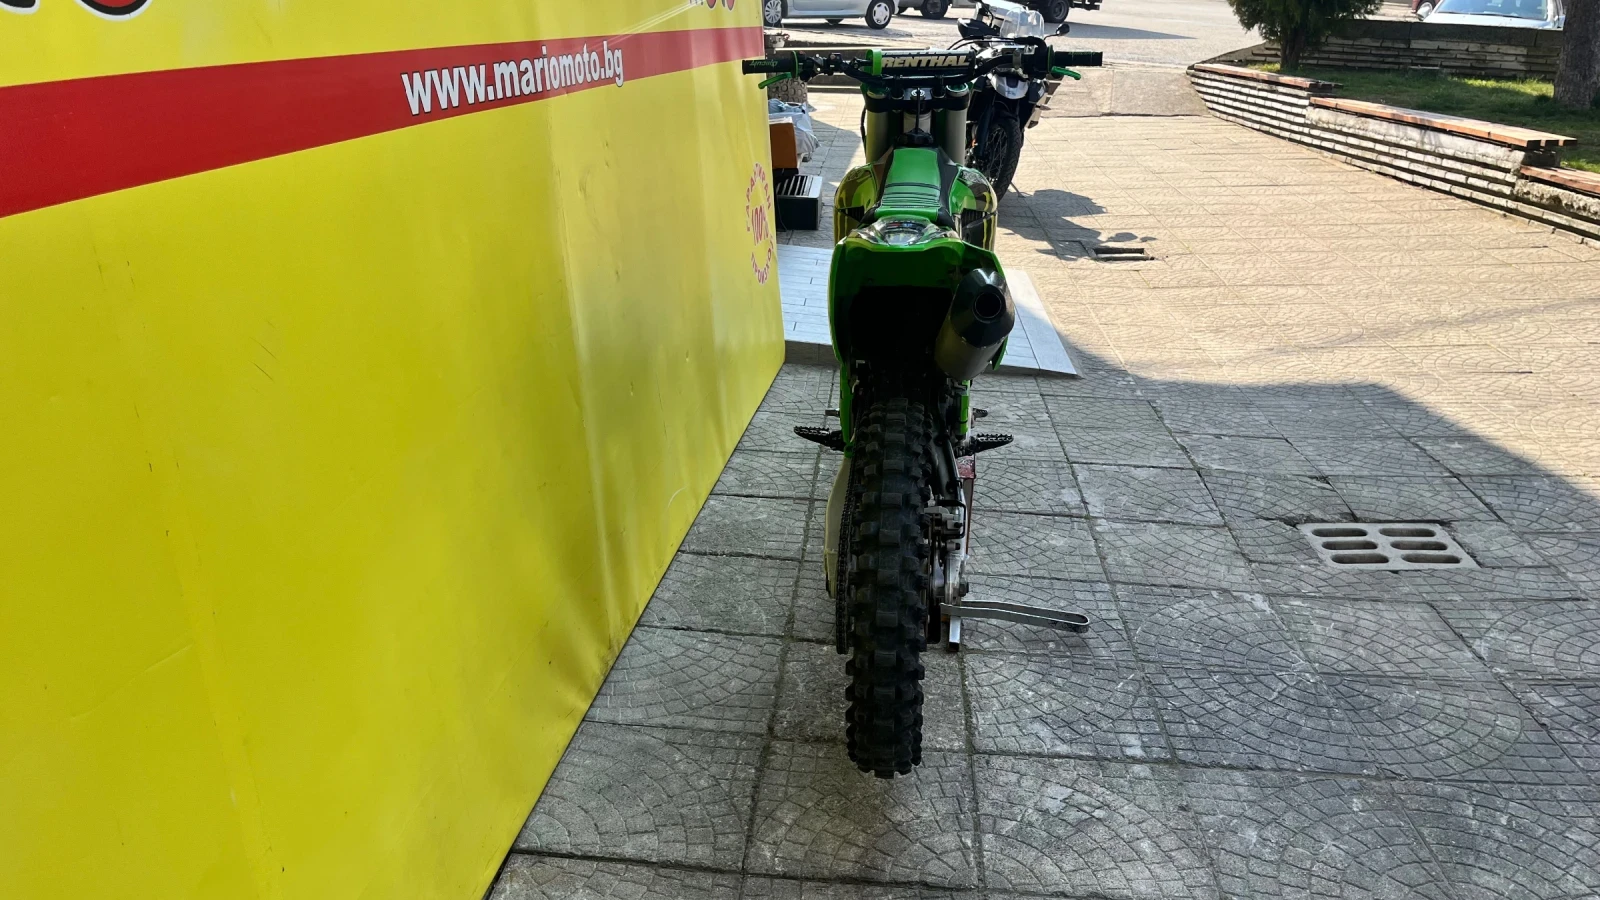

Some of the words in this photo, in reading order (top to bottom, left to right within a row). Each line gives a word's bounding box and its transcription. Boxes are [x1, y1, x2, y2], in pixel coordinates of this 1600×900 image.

[401, 40, 624, 115] www.mariomoto.bg
[881, 55, 970, 68] RENTHAL
[752, 205, 769, 246] 100%
